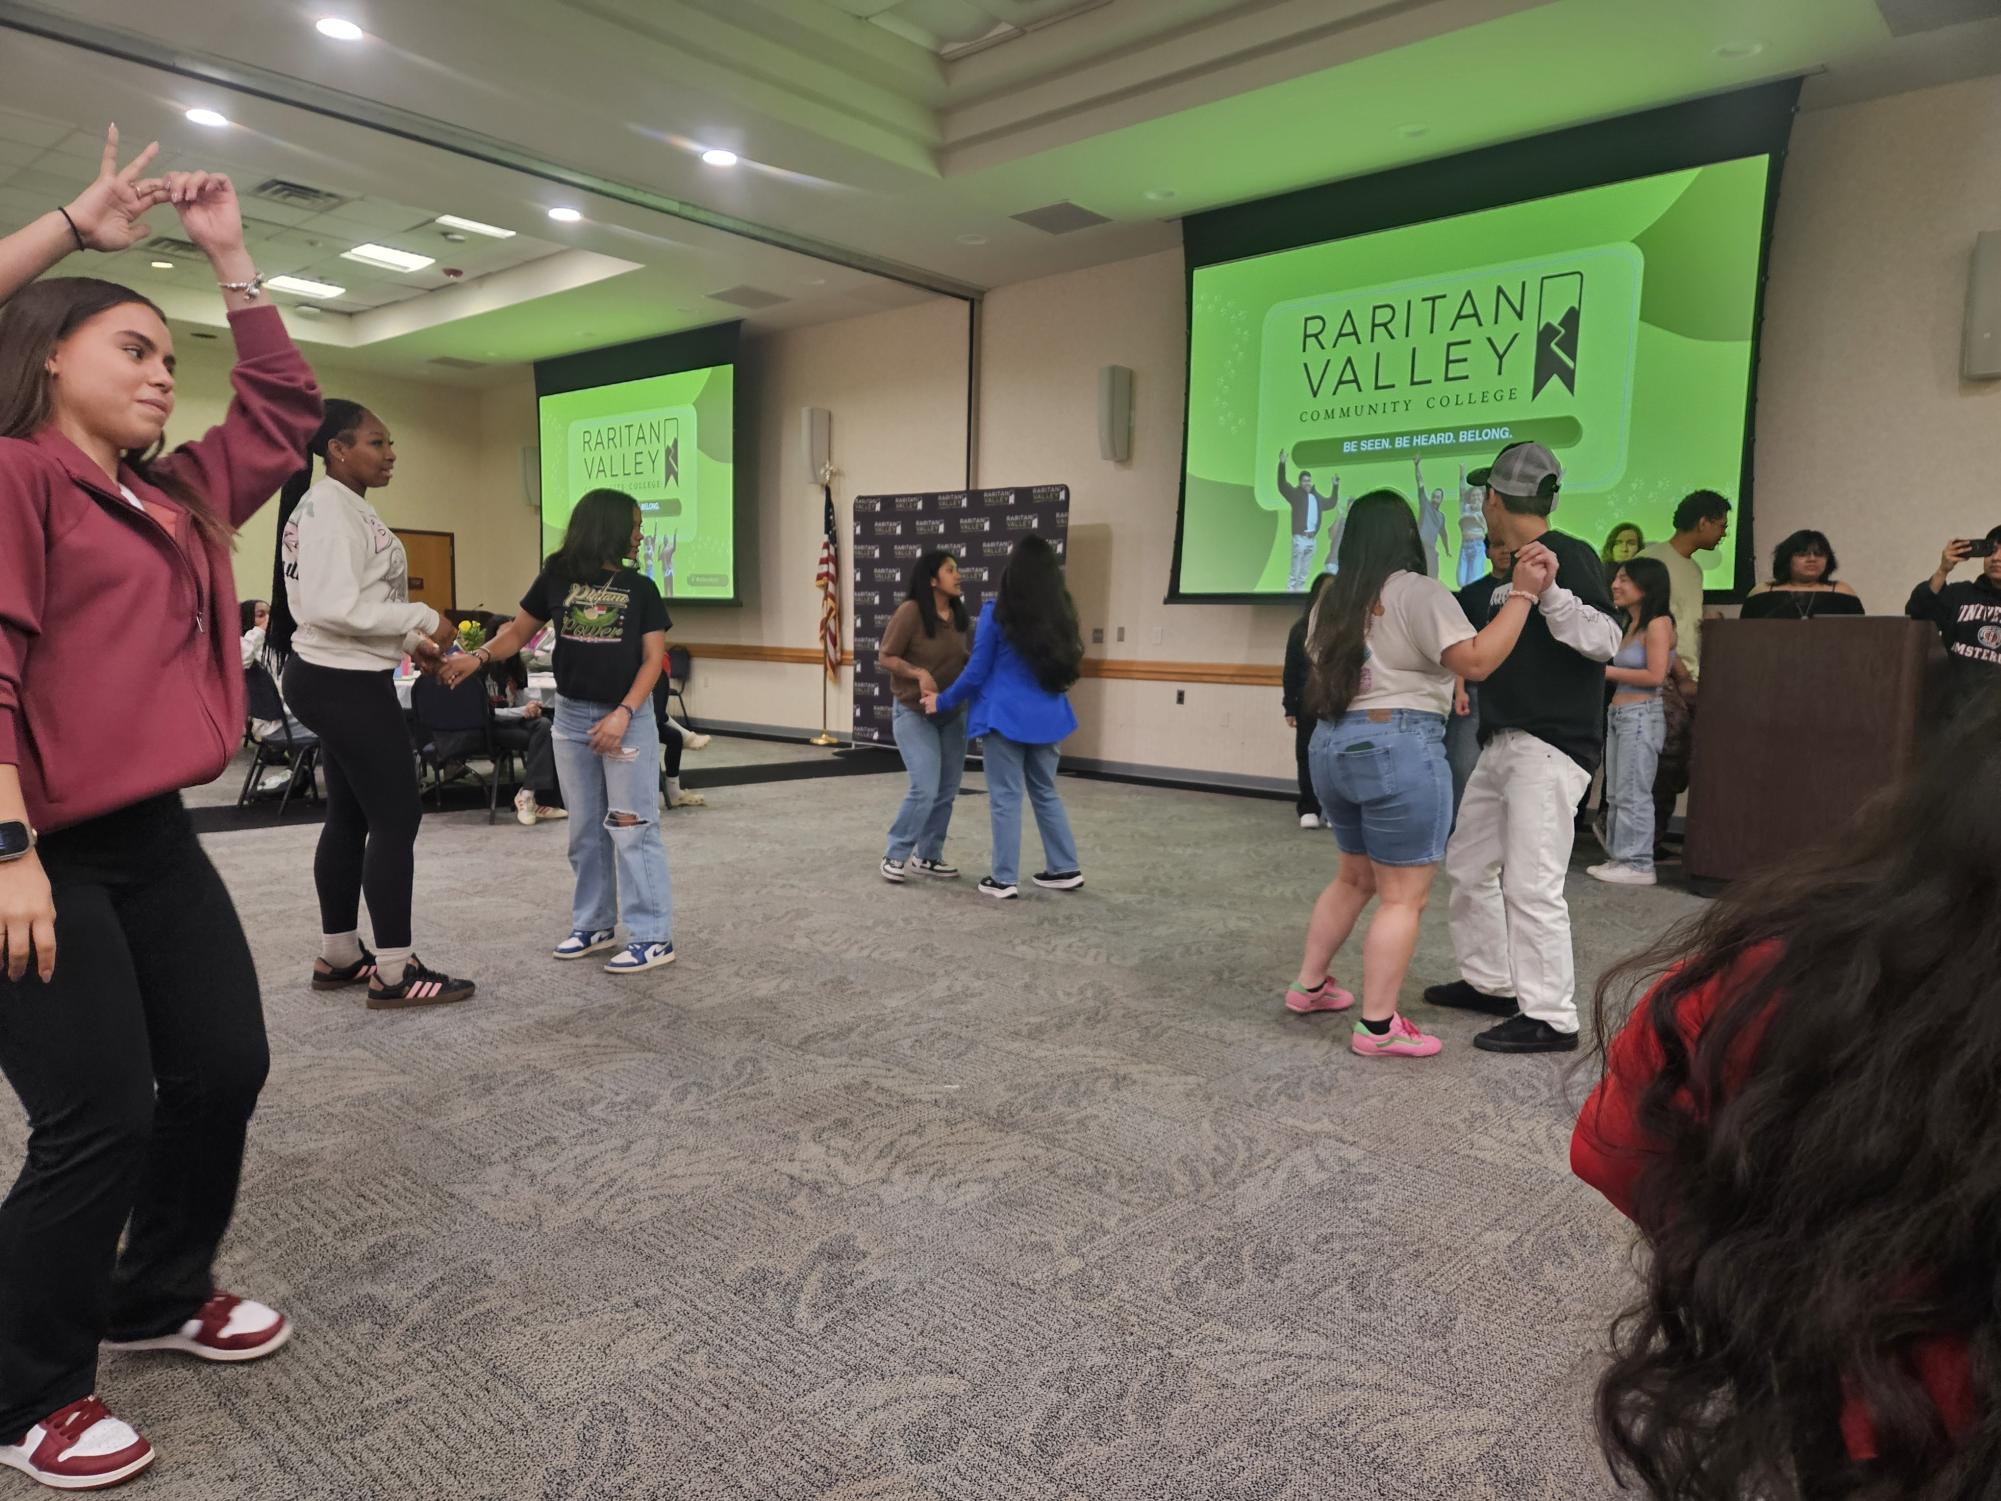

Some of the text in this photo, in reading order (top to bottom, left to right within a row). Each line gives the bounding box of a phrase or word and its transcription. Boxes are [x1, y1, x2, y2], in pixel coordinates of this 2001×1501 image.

[1302, 281, 1526, 352] RARITAN
[1303, 332, 1520, 398] VALLEY
[1300, 388, 1518, 423] COMMUNITY COLLEGE
[583, 420, 660, 452] RARITAN
[1343, 427, 1513, 453] BE SEEN. BE HEARD. BELONG.
[584, 449, 659, 479] VALLEY
